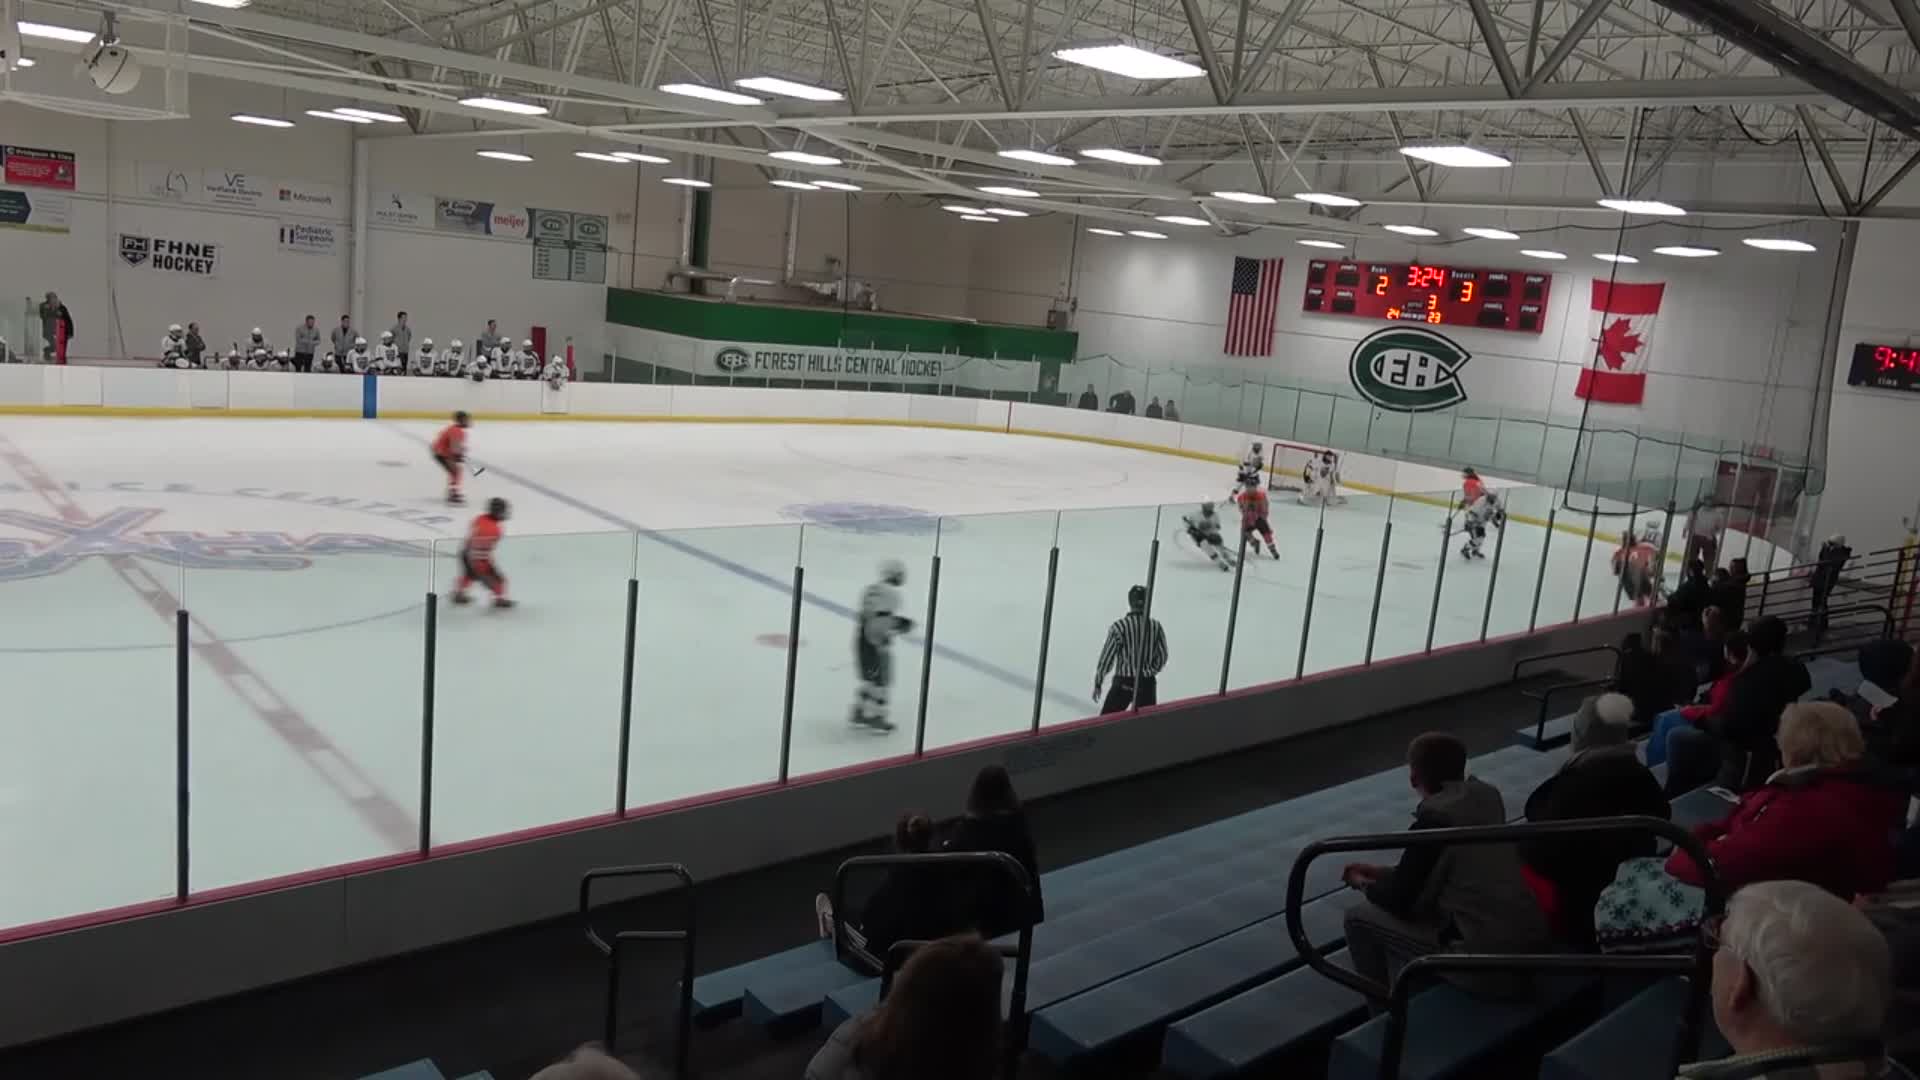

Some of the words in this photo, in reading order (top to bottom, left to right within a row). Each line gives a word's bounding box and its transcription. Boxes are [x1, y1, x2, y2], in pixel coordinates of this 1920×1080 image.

[494, 214, 525, 228] meijer
[153, 239, 216, 258] FHNE
[152, 254, 214, 275] HOCKEY
[1376, 275, 1389, 296] 2
[1407, 265, 1444, 288] 3:24
[1427, 294, 1437, 310] 3
[1460, 281, 1473, 302] 3
[1386, 308, 1400, 320] 24
[1427, 311, 1441, 324] 23
[754, 351, 804, 371] FOREST
[807, 353, 842, 373] HILLS
[845, 356, 897, 376] CENTRAL
[1874, 346, 1920, 374] 9:4
